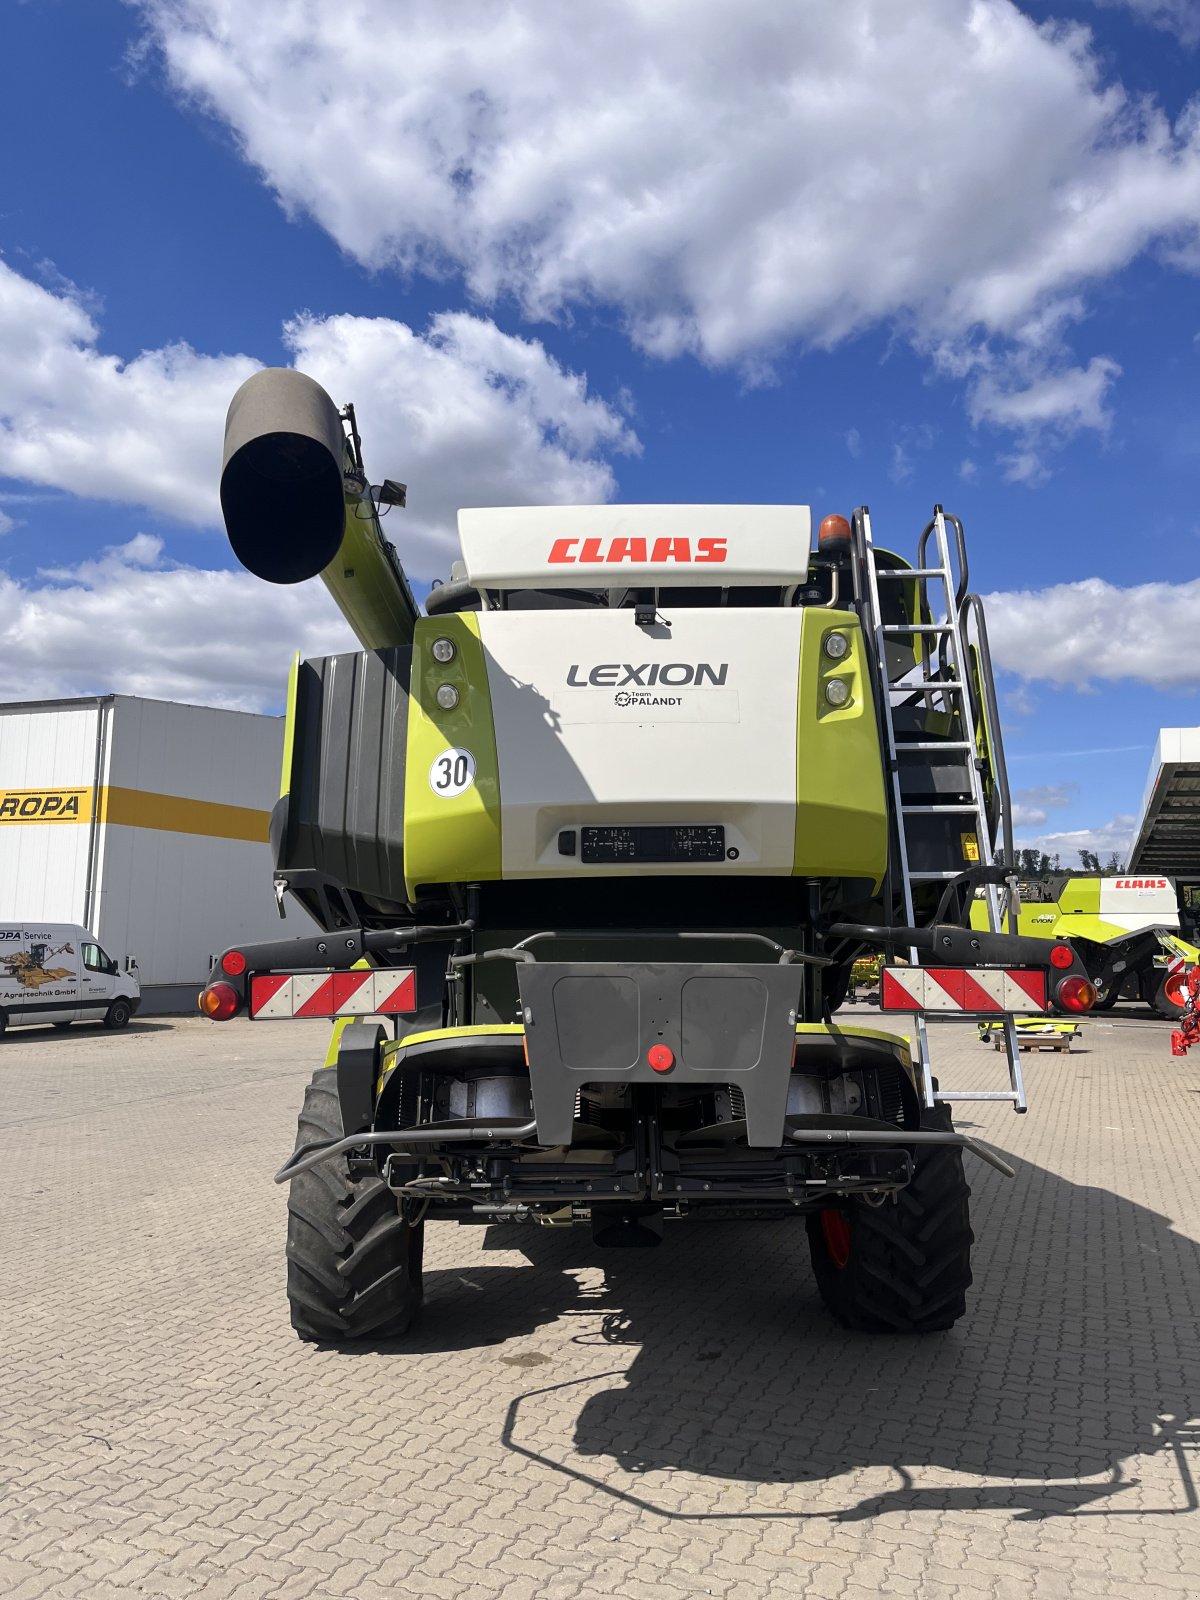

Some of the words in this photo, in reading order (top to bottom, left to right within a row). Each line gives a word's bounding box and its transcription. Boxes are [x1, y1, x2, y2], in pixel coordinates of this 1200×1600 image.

[547, 537, 728, 563] CLAAS
[566, 663, 729, 687] LEXION
[631, 697, 683, 706] PALANDT
[436, 755, 468, 789] 30
[0, 796, 79, 816] ROPA
[1115, 880, 1167, 889] CLAAS
[24, 931, 52, 940] Service
[4, 991, 53, 999] Agrartechnik
